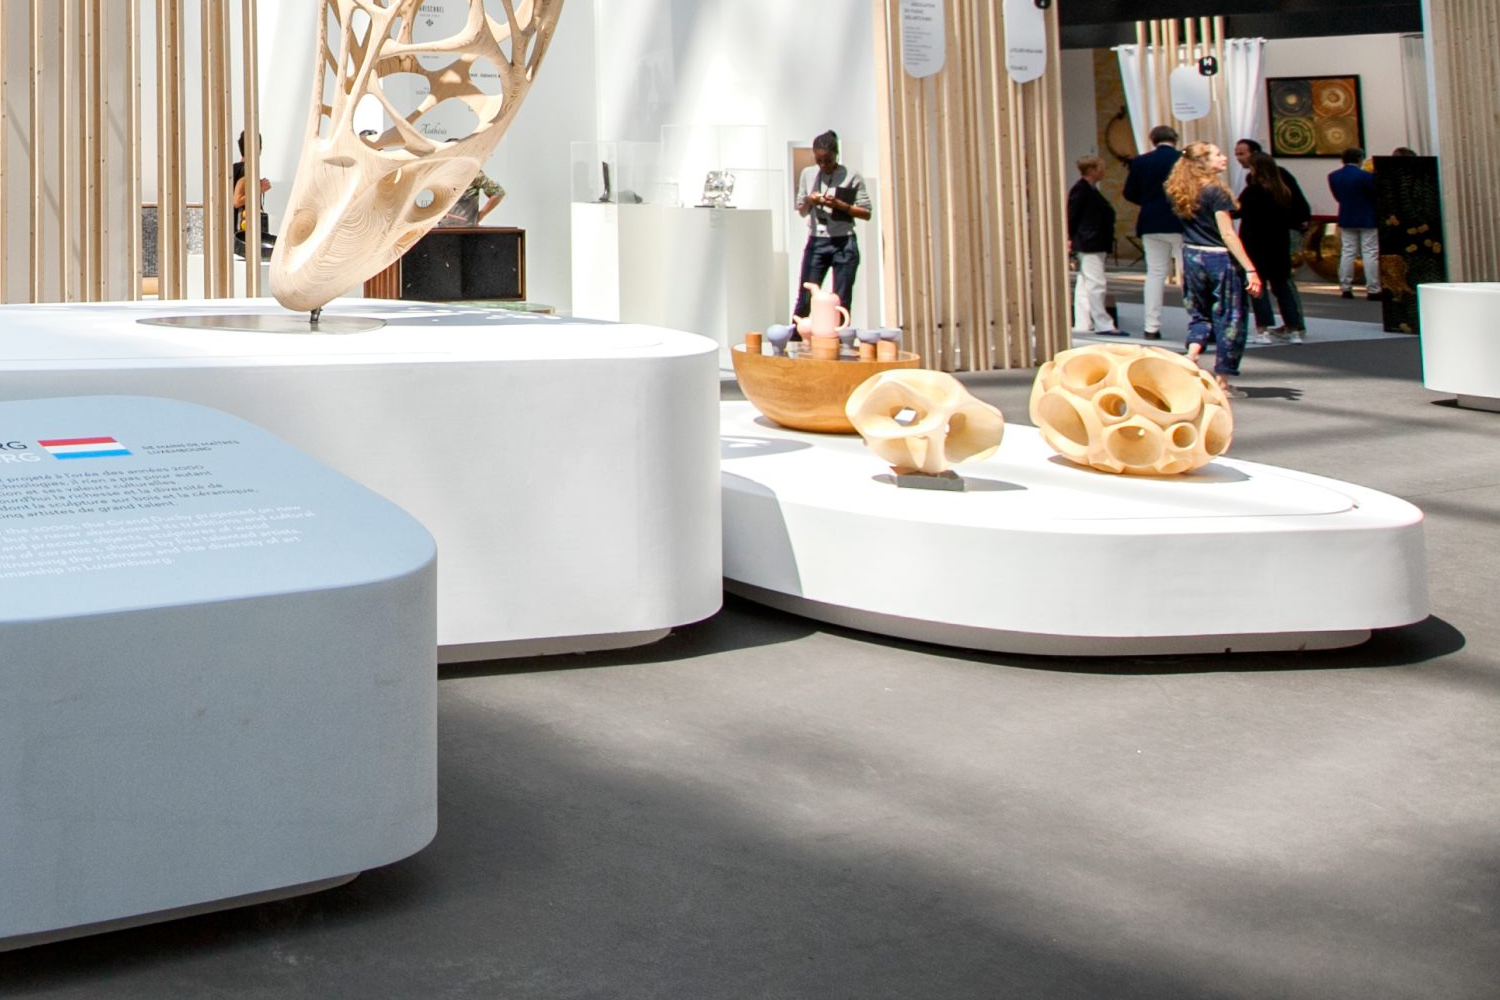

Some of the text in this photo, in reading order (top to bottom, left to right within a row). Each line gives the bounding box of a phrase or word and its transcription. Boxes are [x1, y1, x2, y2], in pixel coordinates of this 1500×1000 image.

[7, 474, 52, 482] projeté
[152, 484, 204, 492] diversité
[98, 503, 135, 512] grand
[5, 526, 29, 534] the
[105, 516, 149, 525] Grand
[150, 513, 193, 522] Duchy
[195, 507, 255, 519] projected
[85, 523, 160, 535] abandoned
[179, 518, 241, 527] traditions
[243, 514, 267, 522] and
[268, 510, 316, 519] cultural
[1, 543, 28, 551] and
[31, 539, 90, 550] precious
[148, 529, 216, 538] sculptures
[235, 522, 269, 530] wood
[105, 540, 154, 550] shaped
[202, 531, 257, 541] talented
[96, 551, 152, 560] richness
[155, 546, 180, 554] and
[182, 544, 206, 552] the
[206, 540, 264, 549] diversity
